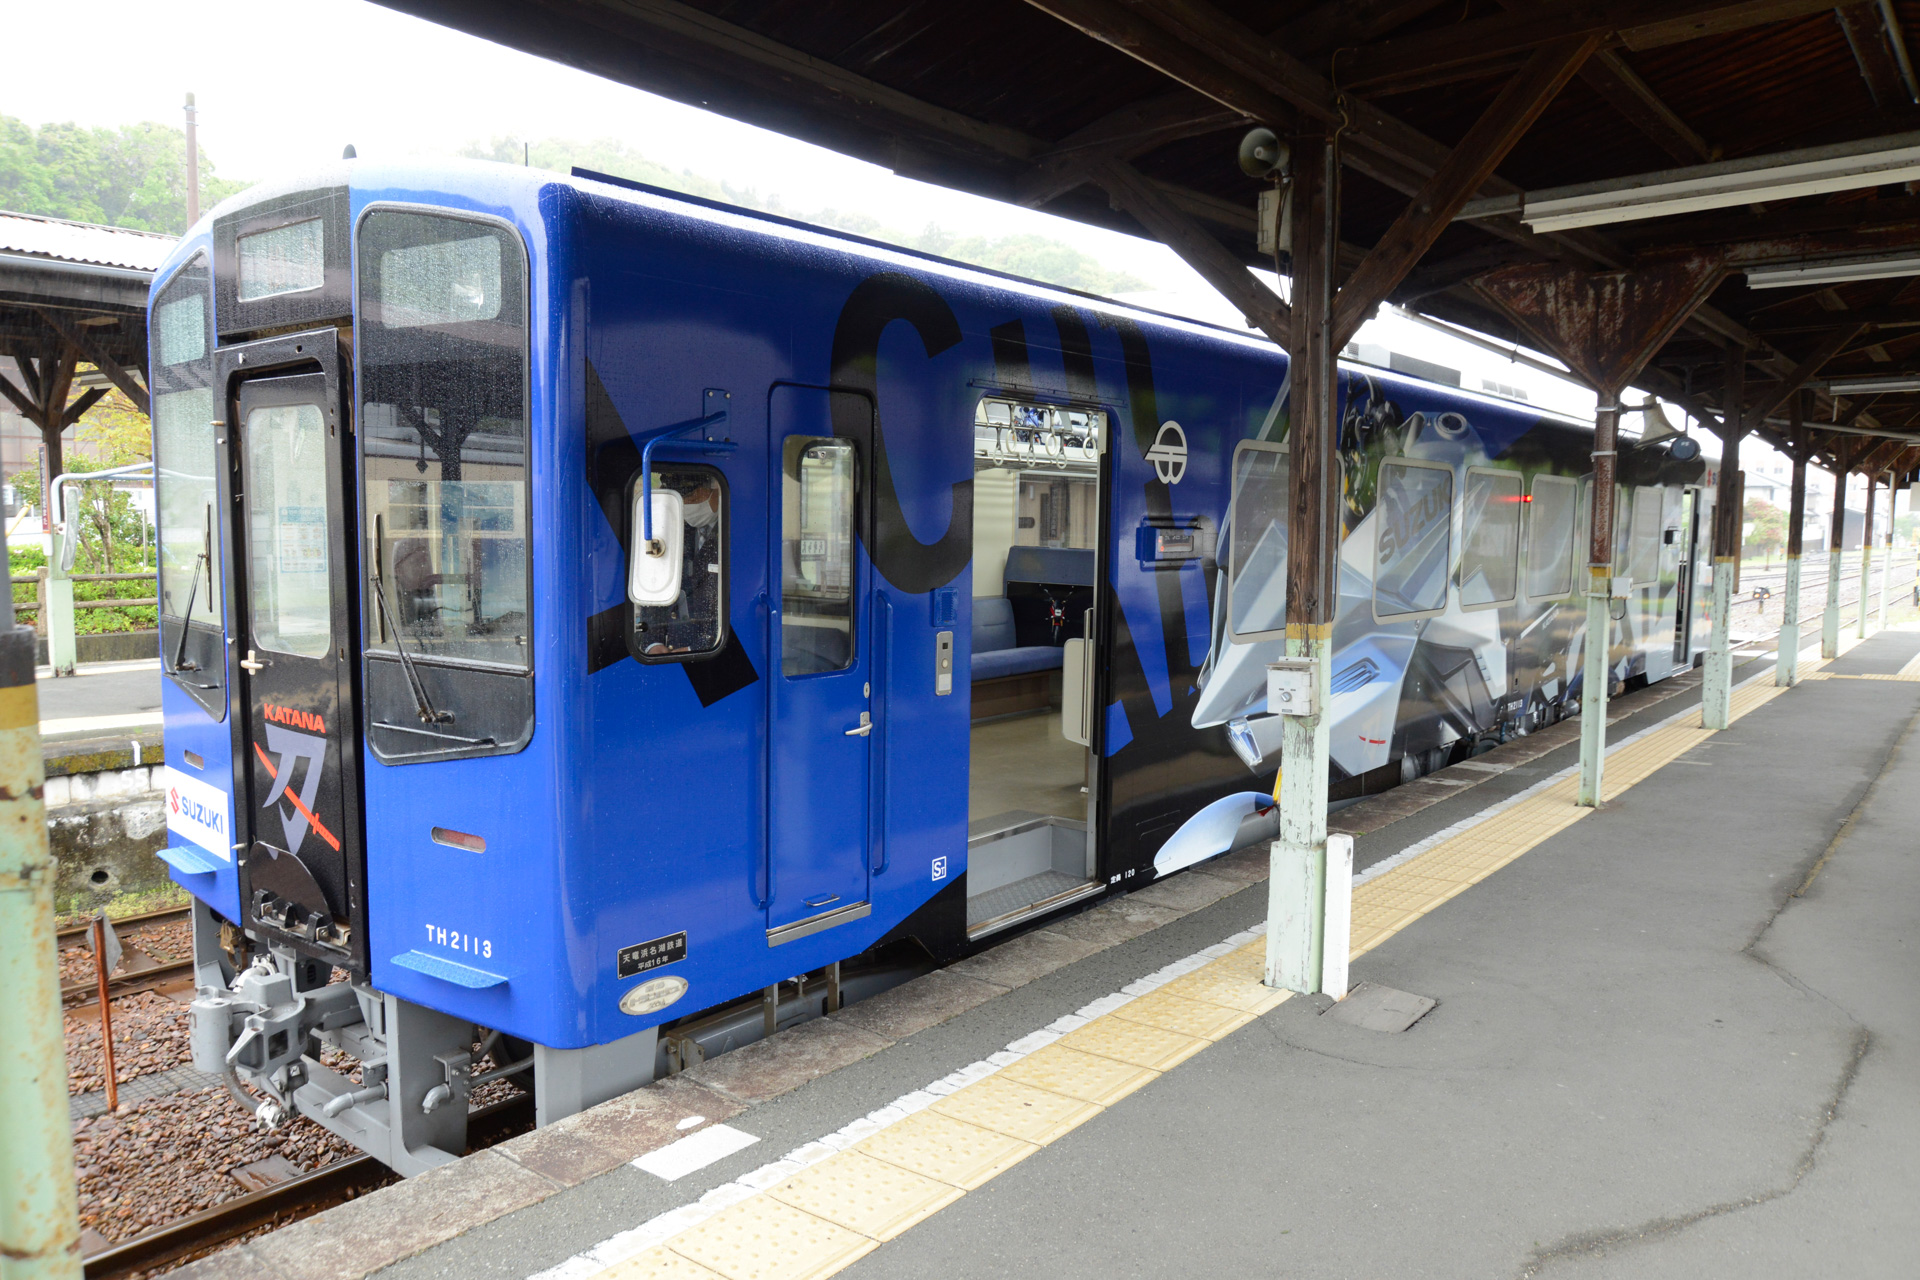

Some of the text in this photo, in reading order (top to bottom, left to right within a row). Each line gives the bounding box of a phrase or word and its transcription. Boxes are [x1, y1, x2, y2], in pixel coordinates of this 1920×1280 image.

[1379, 476, 1453, 565] SUZUK
[264, 703, 326, 733] KATANA
[262, 722, 328, 857] 刀
[182, 796, 224, 835] SUZUKI
[1124, 868, 1135, 879] 120
[425, 924, 492, 958] TH2113
